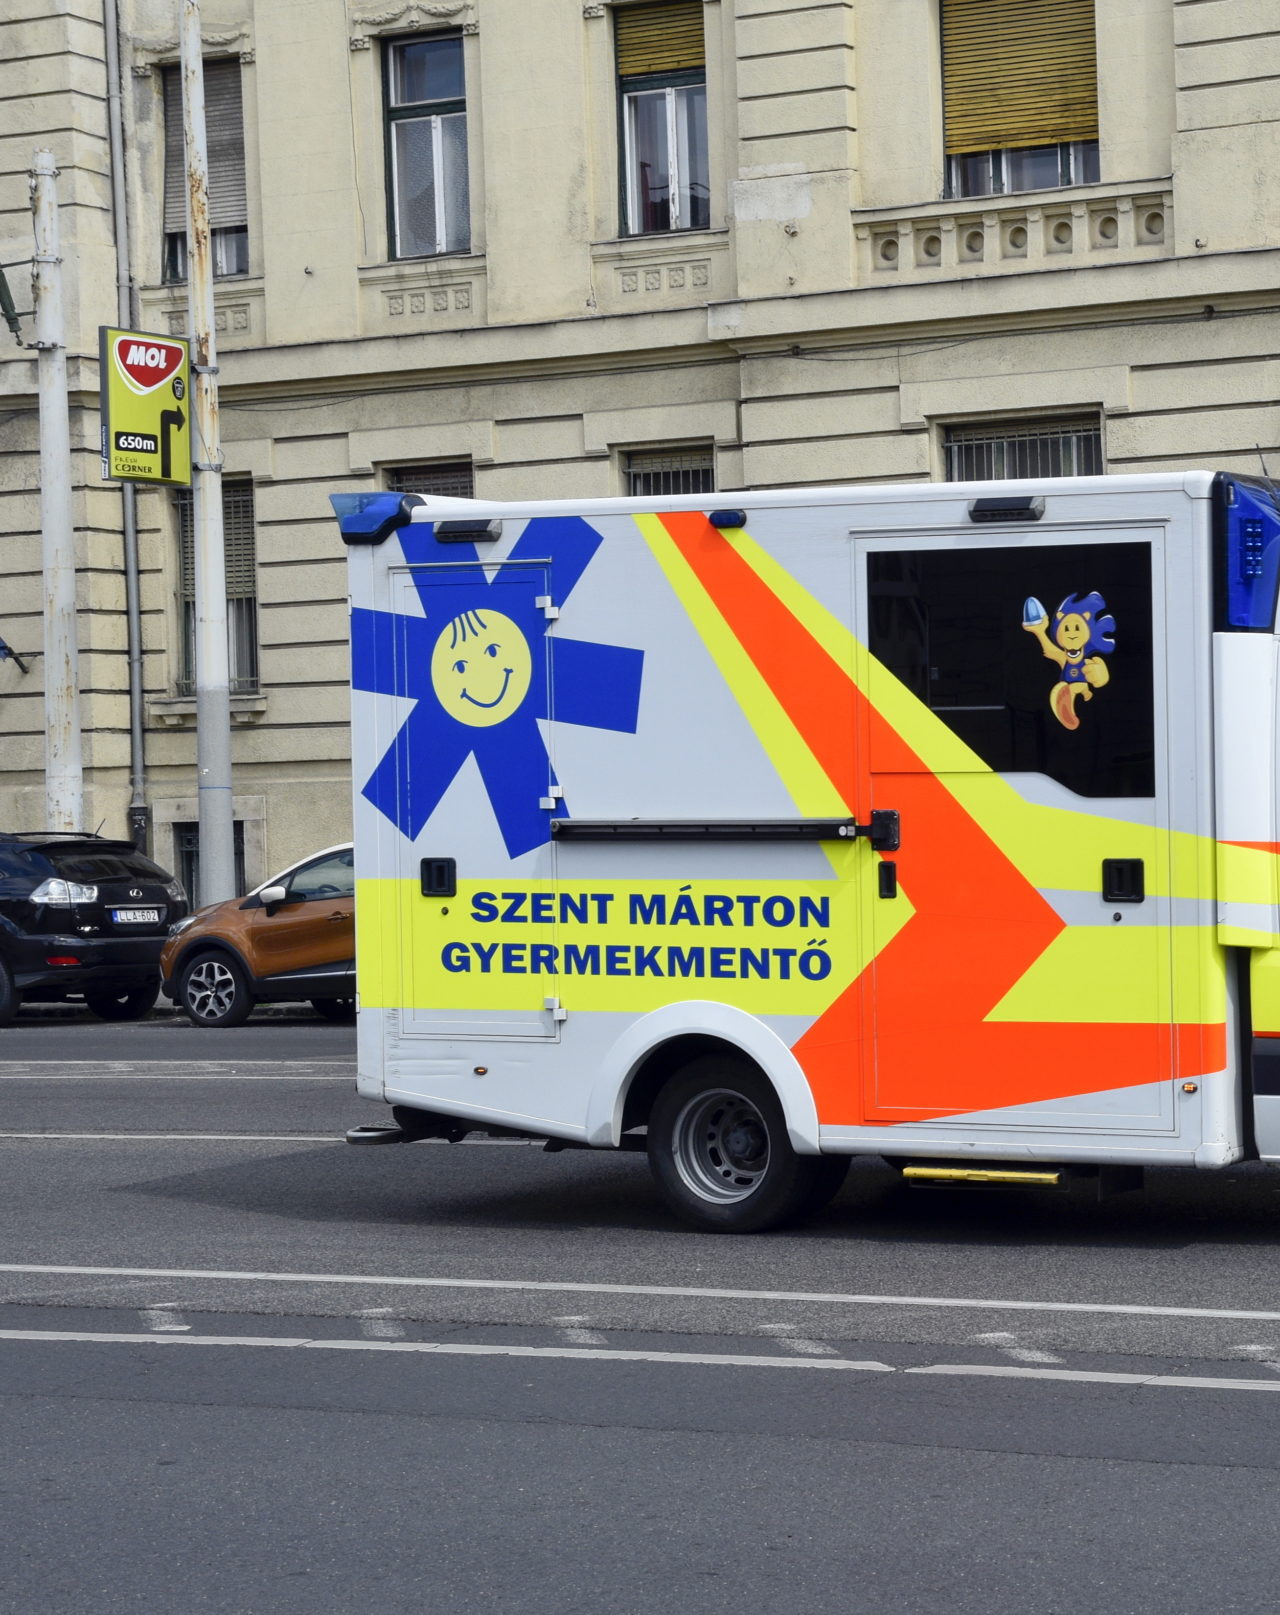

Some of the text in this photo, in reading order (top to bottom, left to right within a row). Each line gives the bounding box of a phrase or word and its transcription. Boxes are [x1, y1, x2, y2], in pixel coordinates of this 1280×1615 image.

[126, 345, 167, 369] MOL
[119, 436, 155, 450] 650m
[115, 464, 152, 473] CORNER
[470, 884, 831, 928] SZENT MÁRTON
[120, 911, 157, 921] LLA-602
[440, 938, 833, 981] GYERMEKMENTŐ
